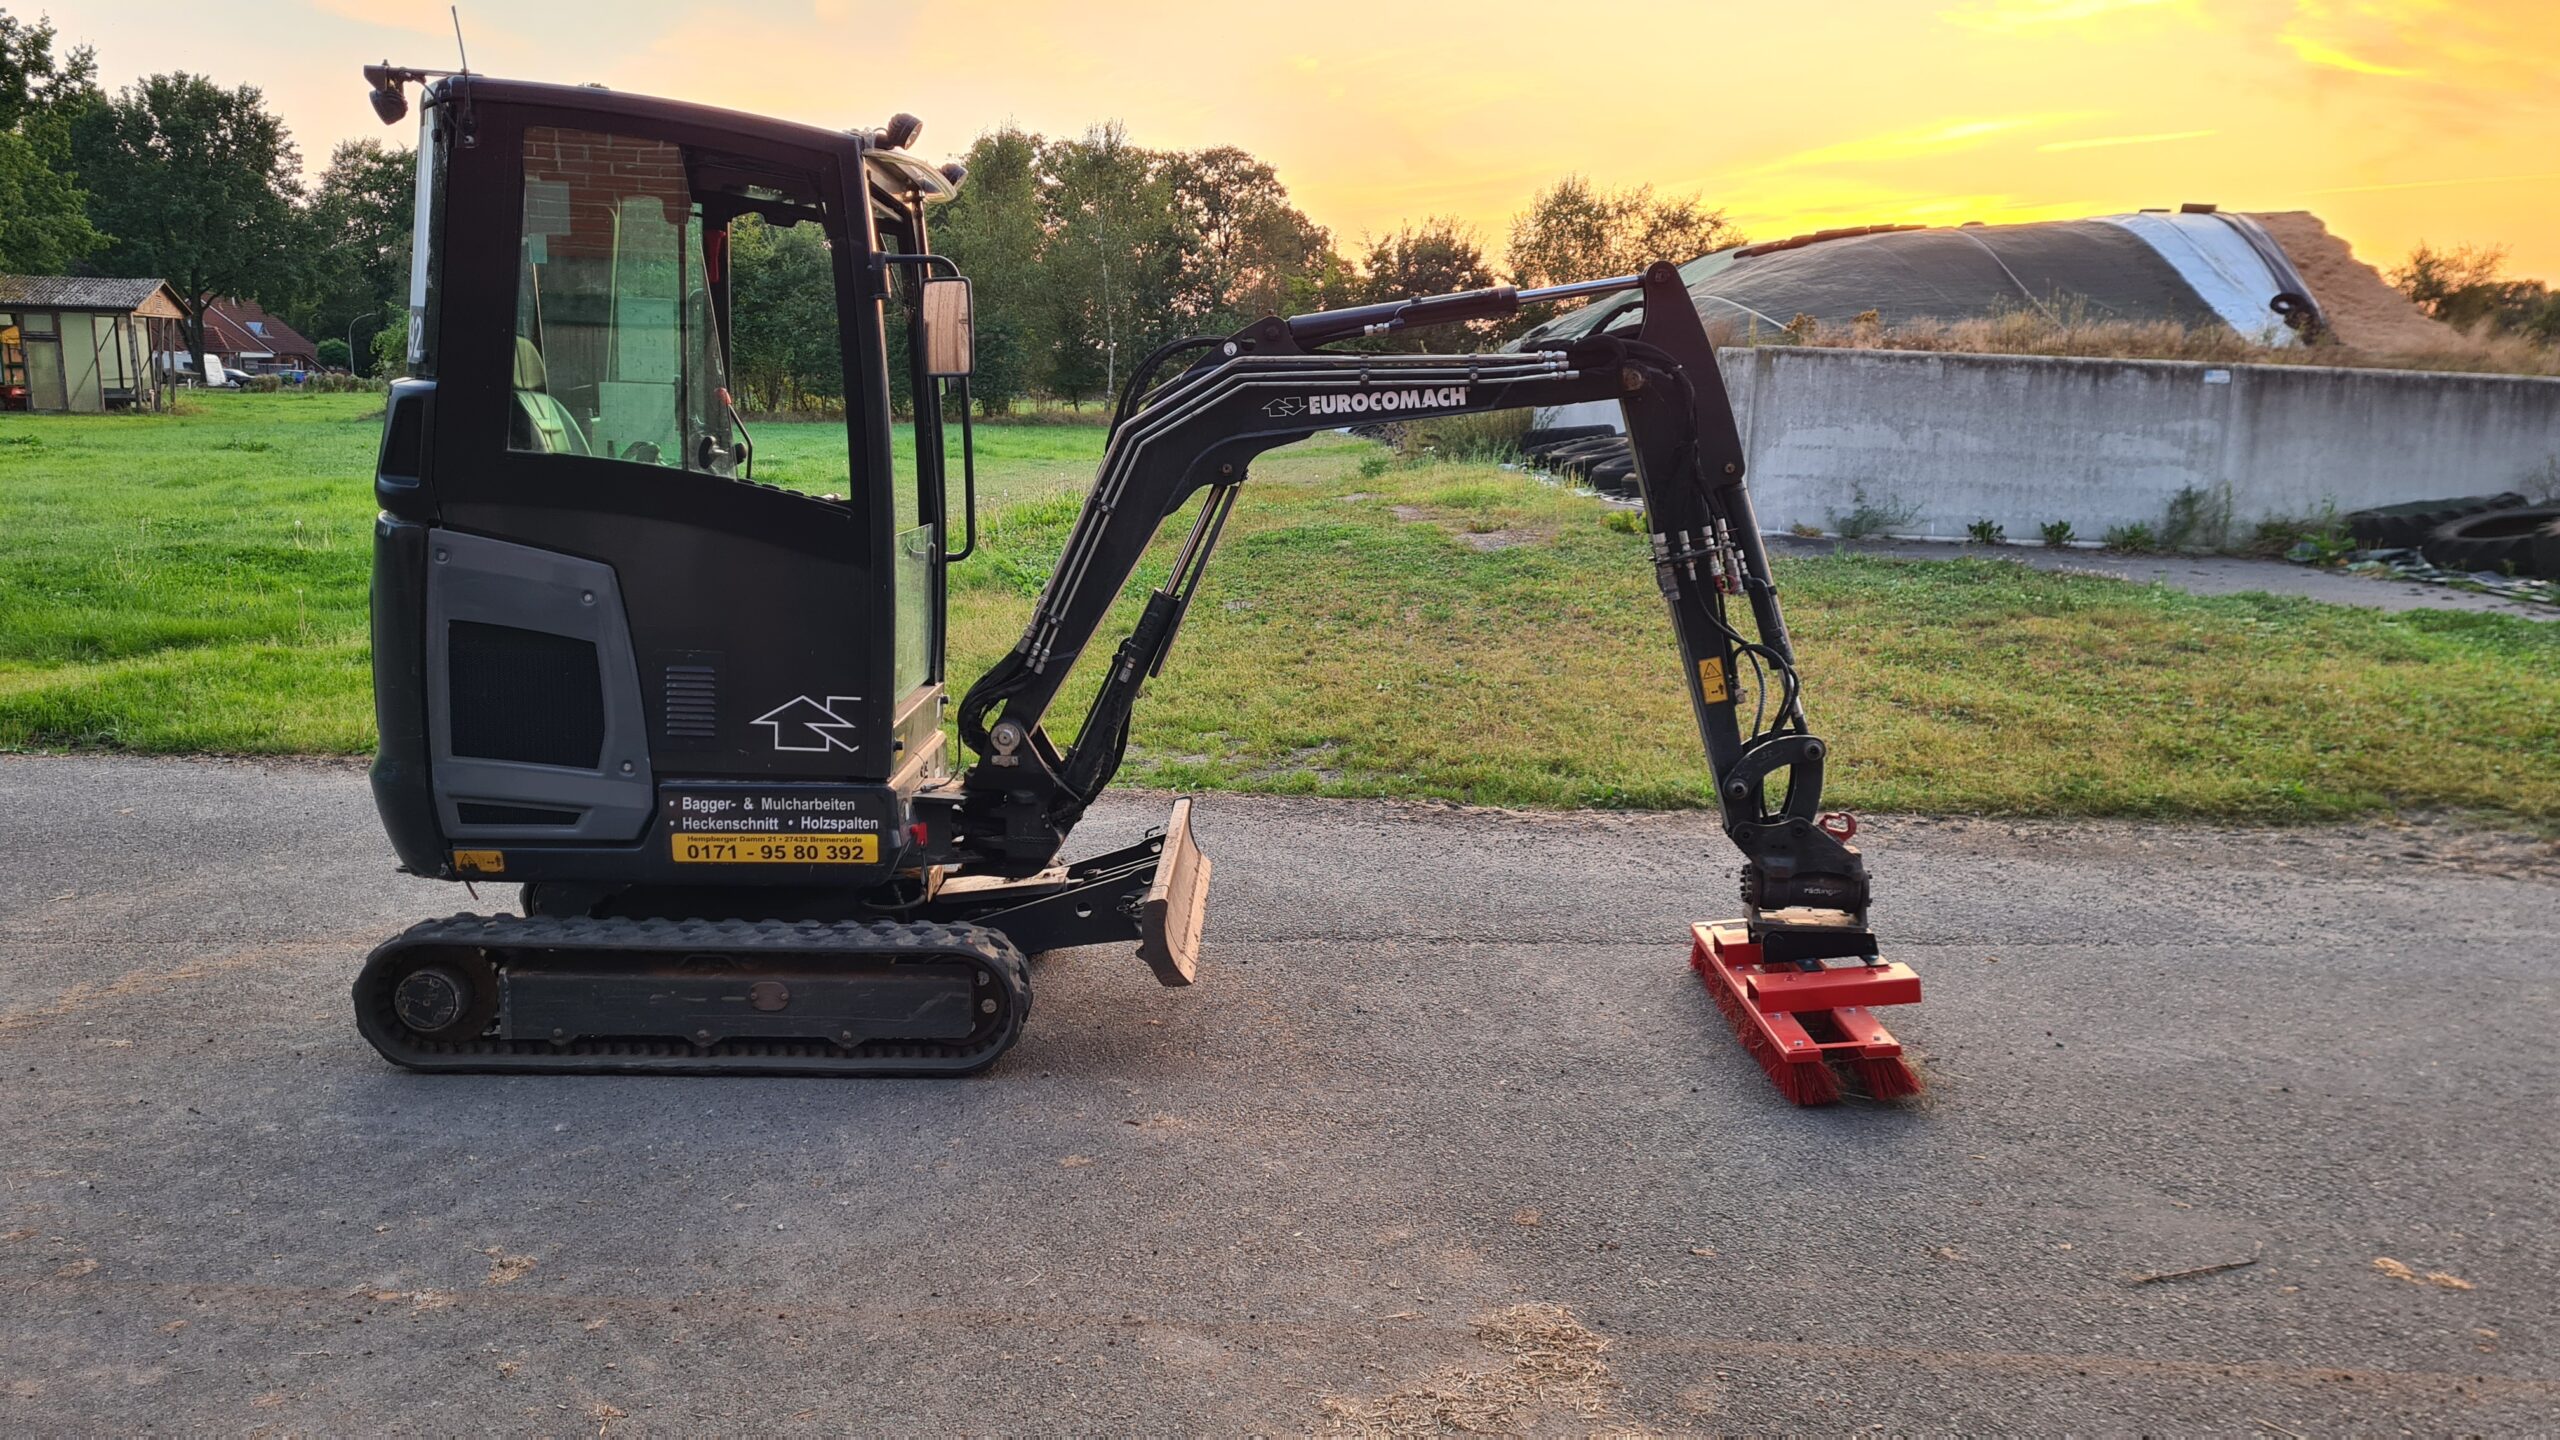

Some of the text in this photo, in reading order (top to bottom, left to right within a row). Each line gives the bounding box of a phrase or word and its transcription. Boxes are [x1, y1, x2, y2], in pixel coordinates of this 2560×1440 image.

[1308, 386, 1467, 415] EUROCOMACH
[682, 796, 856, 813] Bagger- & Mulcharbeiten
[682, 816, 879, 832] Heckenschnitt Holzspalten
[687, 835, 737, 844] Hempberger
[739, 835, 766, 843] Damm
[810, 836, 863, 844] Bremervörde
[687, 844, 737, 860] 0171
[760, 845, 786, 860] 95
[793, 845, 819, 860] 80
[826, 845, 864, 860] 392
